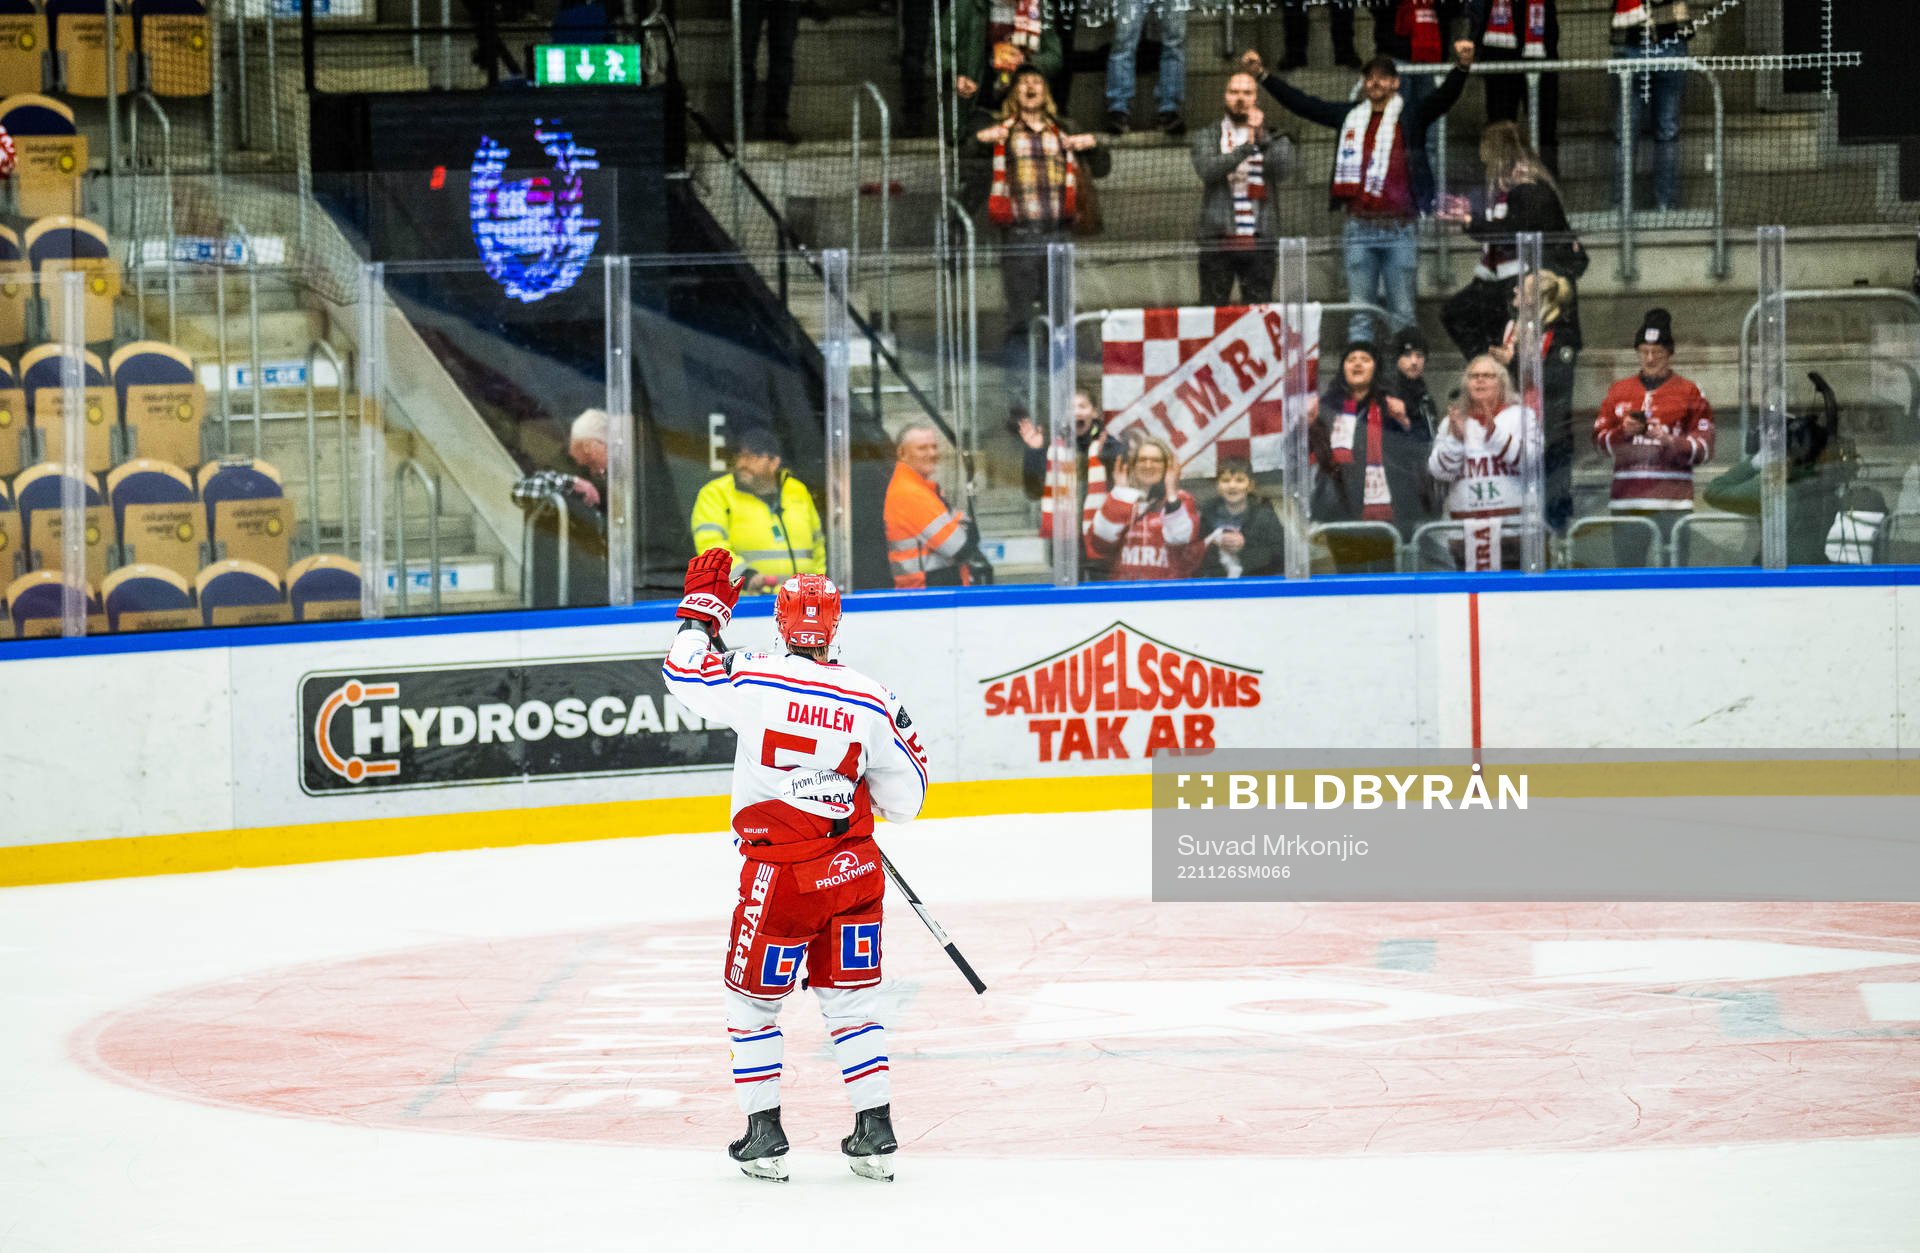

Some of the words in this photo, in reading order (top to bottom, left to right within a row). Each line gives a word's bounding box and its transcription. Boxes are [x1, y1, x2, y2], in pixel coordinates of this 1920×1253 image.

[709, 413, 725, 471] E
[801, 634, 816, 645] 54
[984, 629, 1262, 716] SAMUELSSONS
[353, 694, 732, 755] HYDROSCAN
[787, 701, 855, 734] DAHLÉN
[1029, 716, 1130, 762] TAK
[1144, 713, 1216, 758] AB
[733, 876, 771, 971] PEAB
